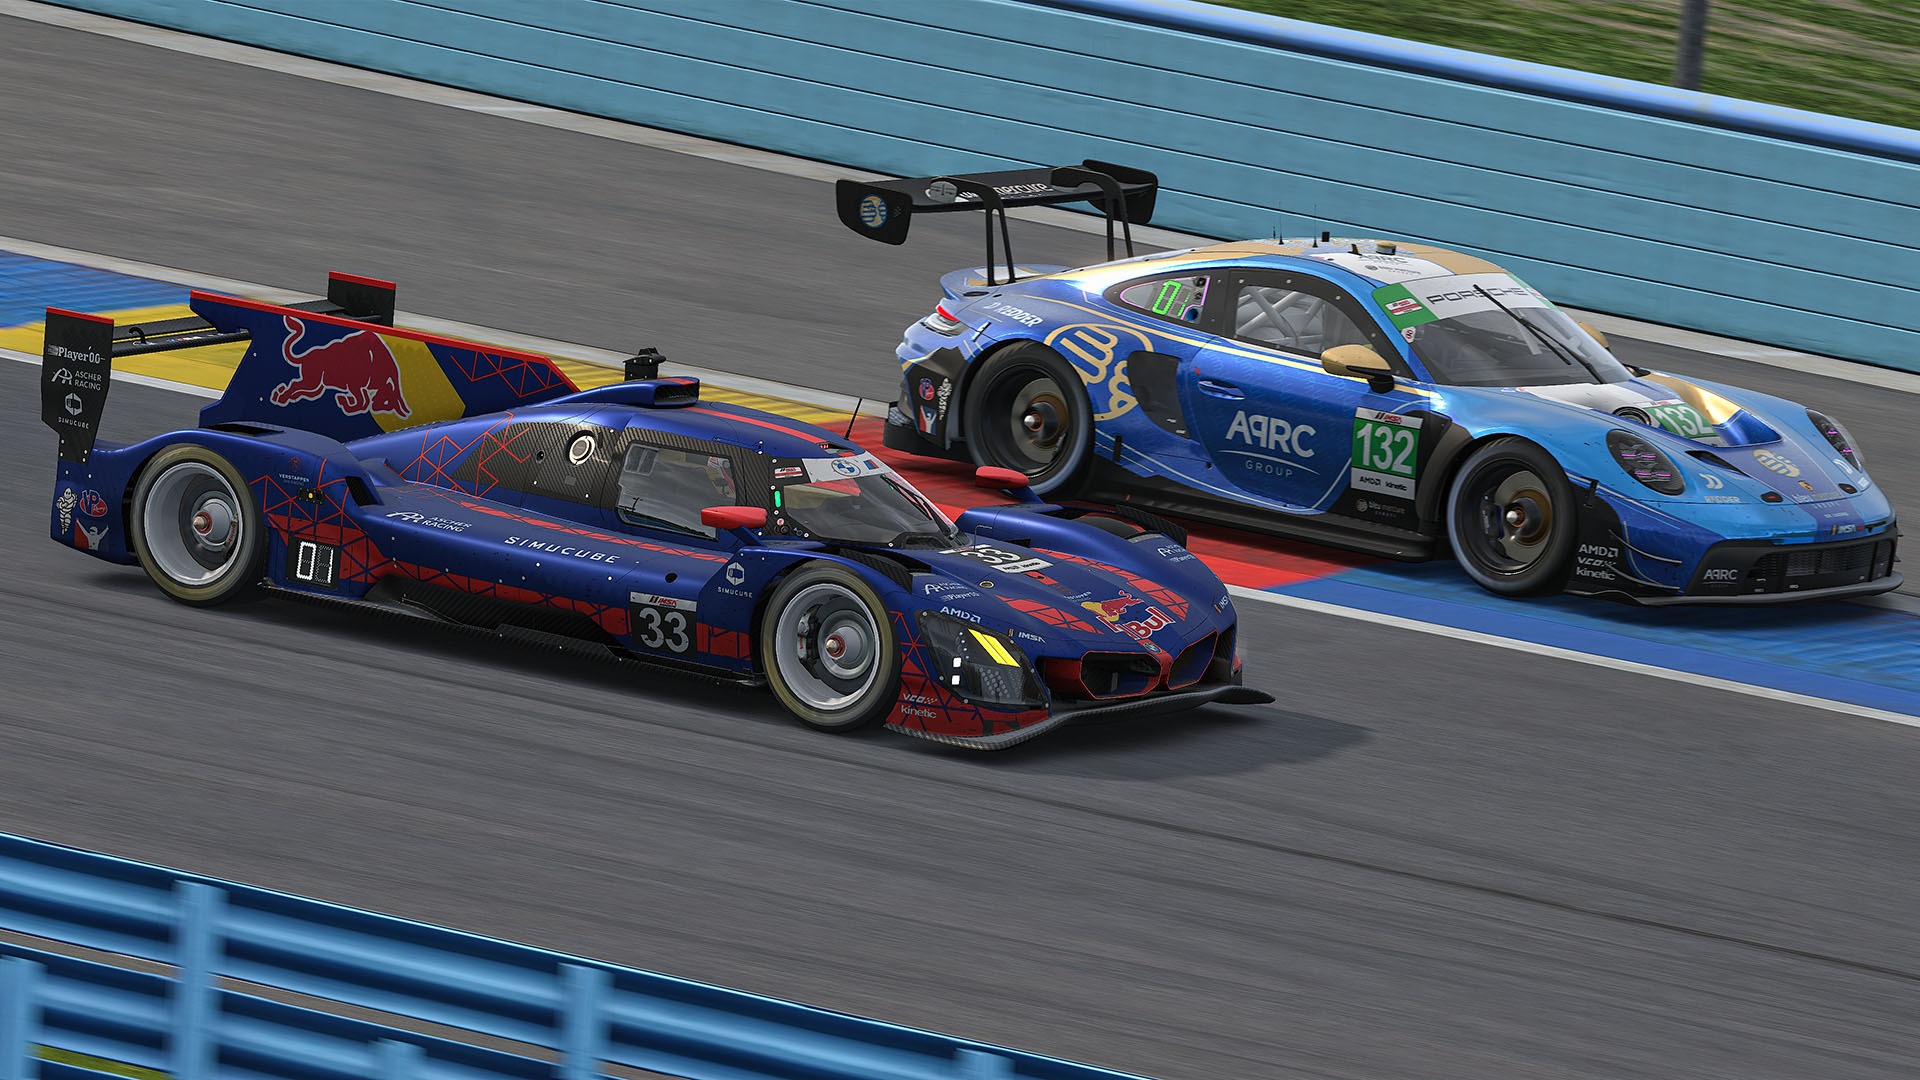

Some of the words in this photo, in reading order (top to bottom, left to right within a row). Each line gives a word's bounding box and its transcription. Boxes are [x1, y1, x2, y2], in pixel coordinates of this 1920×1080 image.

[993, 305, 1044, 328] REDDER
[75, 371, 102, 382] ASCHER
[75, 379, 101, 391] RACING
[1655, 404, 1715, 437] 132
[1357, 423, 1416, 475] 132
[1245, 459, 1293, 478] GROUP
[421, 519, 464, 533] RACING
[430, 516, 473, 528] ASCHER
[504, 536, 620, 564] SIMUCUBE
[1578, 543, 1608, 557] AMD
[296, 541, 334, 584] 01
[1576, 567, 1616, 581] kinetic
[717, 586, 753, 599] SIMUCUBE
[940, 606, 971, 620] AMD
[639, 607, 690, 653] 33
[1120, 606, 1176, 640] Bull
[1018, 631, 1046, 643] IMSA
[901, 705, 936, 719] kinetic
